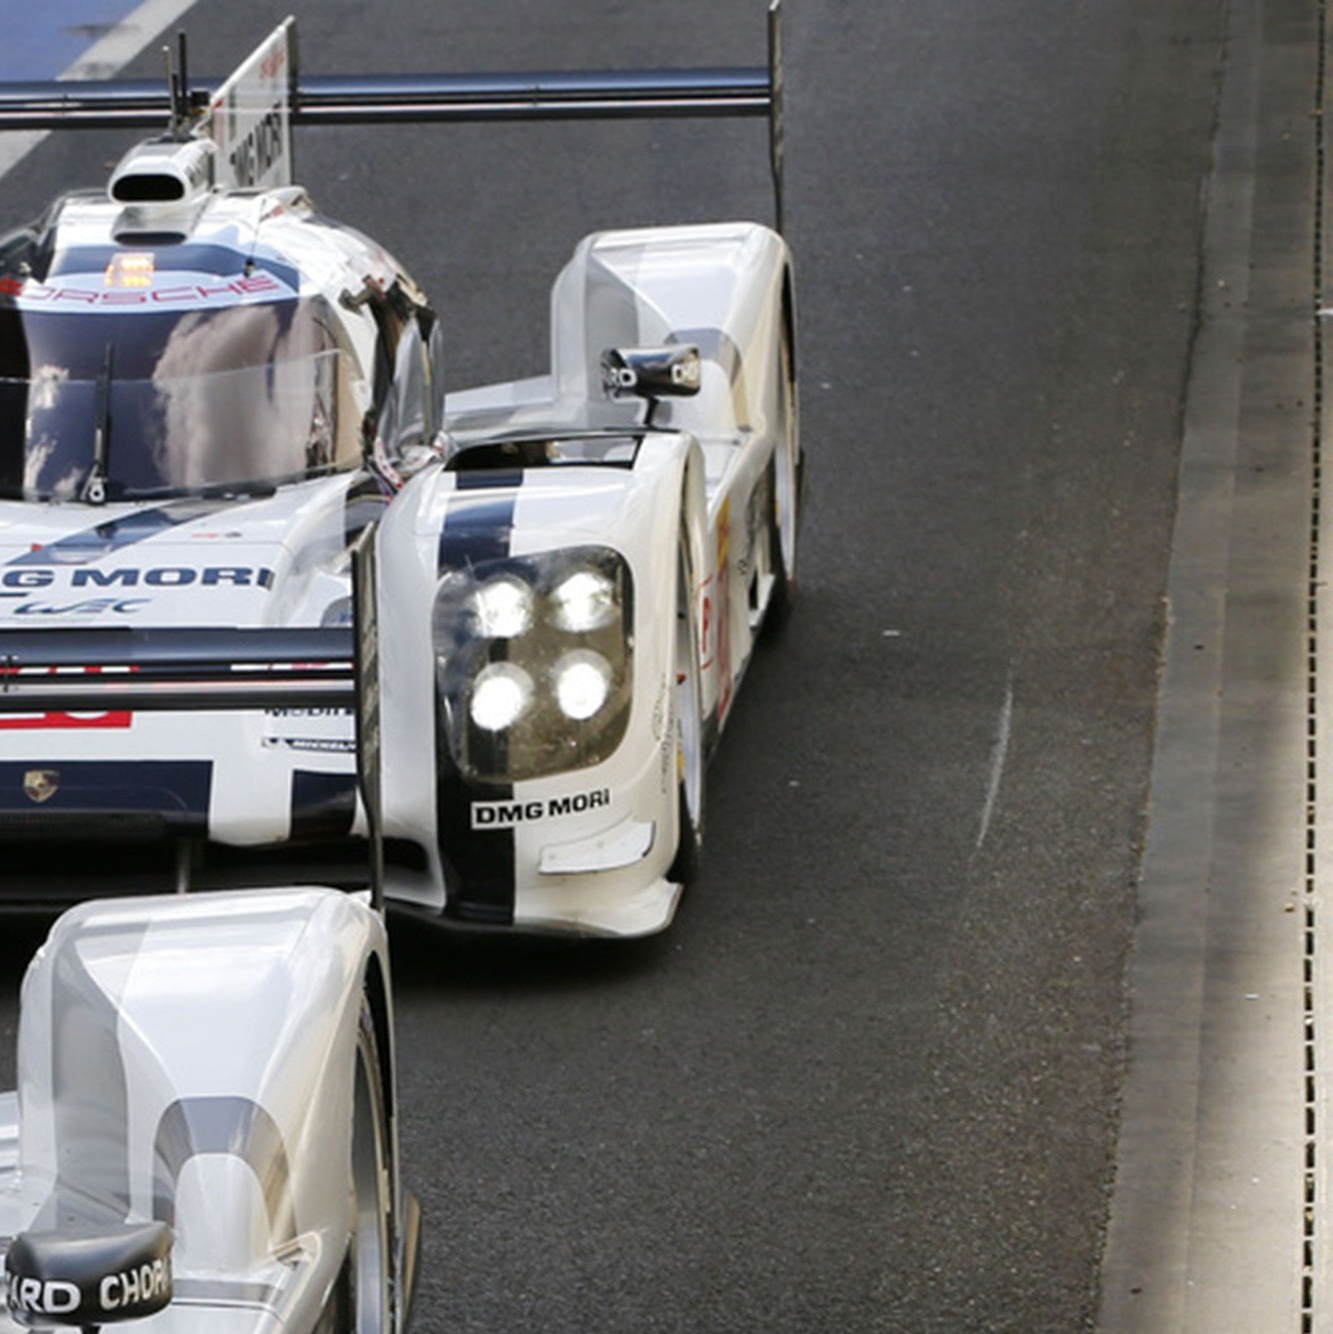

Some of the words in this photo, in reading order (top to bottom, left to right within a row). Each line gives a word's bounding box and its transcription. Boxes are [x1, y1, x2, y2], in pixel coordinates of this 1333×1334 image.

[70, 567, 276, 592] MORI
[475, 801, 543, 824] DMG
[549, 788, 610, 816] MORI
